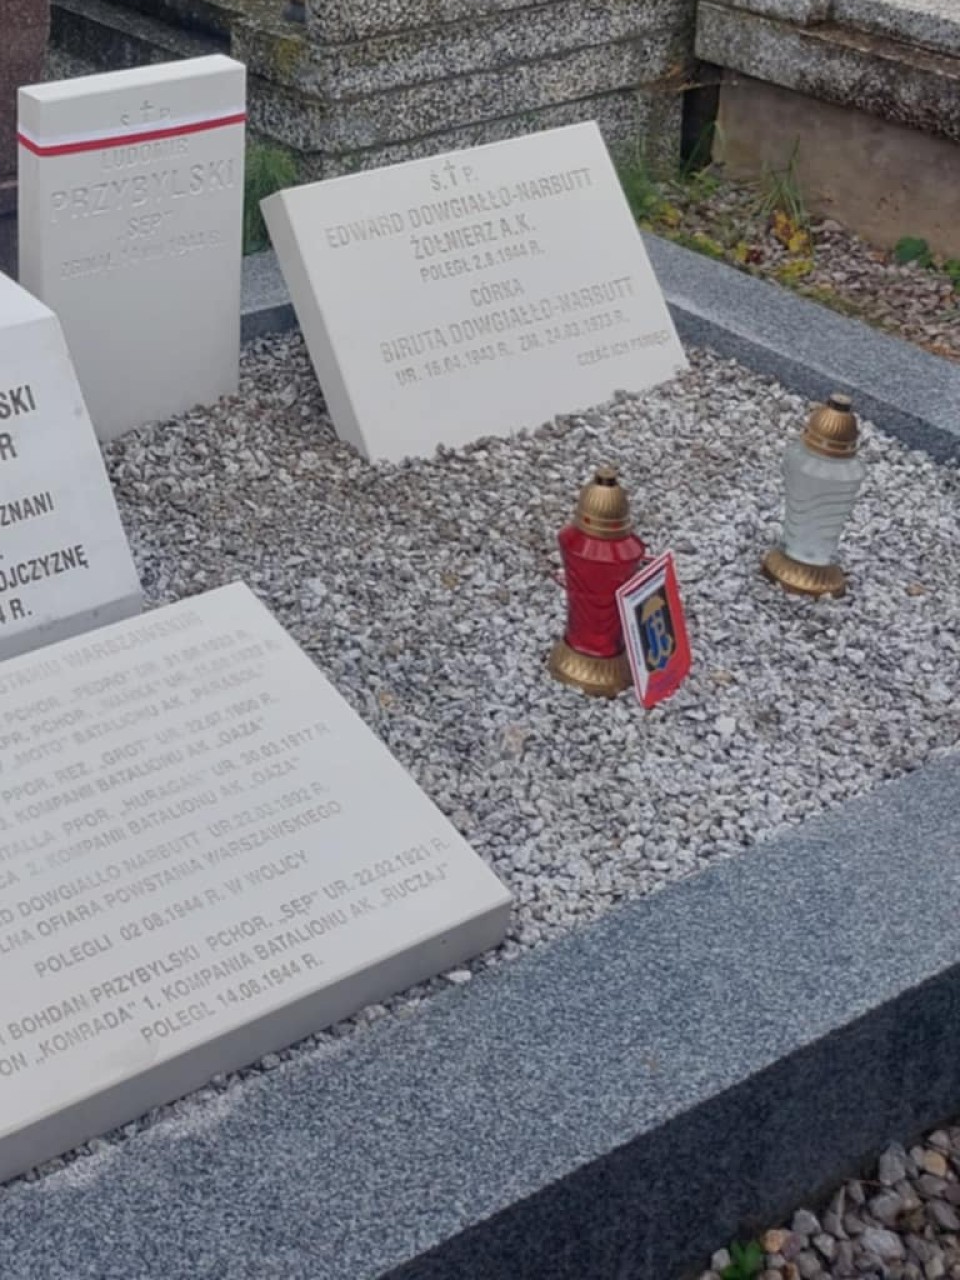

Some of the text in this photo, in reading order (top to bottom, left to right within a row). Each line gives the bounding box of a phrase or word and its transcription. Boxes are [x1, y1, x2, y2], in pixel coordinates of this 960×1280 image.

[49, 159, 237, 224] PRZYBYLSKI
[322, 210, 406, 250] EDWARD
[406, 210, 537, 261] ŻOŁNIERZ A.K.
[466, 272, 526, 309] CÓRKA
[378, 326, 449, 364] BIRUTA
[7, 594, 33, 621] R.
[33, 897, 105, 938] OFIARA
[101, 855, 206, 910] POWSTANIA
[200, 797, 347, 868] WARSZAWSKIEGO
[30, 931, 116, 980] POLEGLI
[221, 875, 245, 896] W
[241, 846, 314, 888] WOLICY
[4, 991, 91, 1042] BOHDAN
[86, 941, 203, 1005] PRZYBYLSKI
[202, 910, 275, 953] PCHOR.
[139, 990, 163, 1012] 1.
[158, 947, 257, 1004] KOMPANIA
[250, 905, 351, 962] BATALIONU
[343, 893, 378, 918] AK
